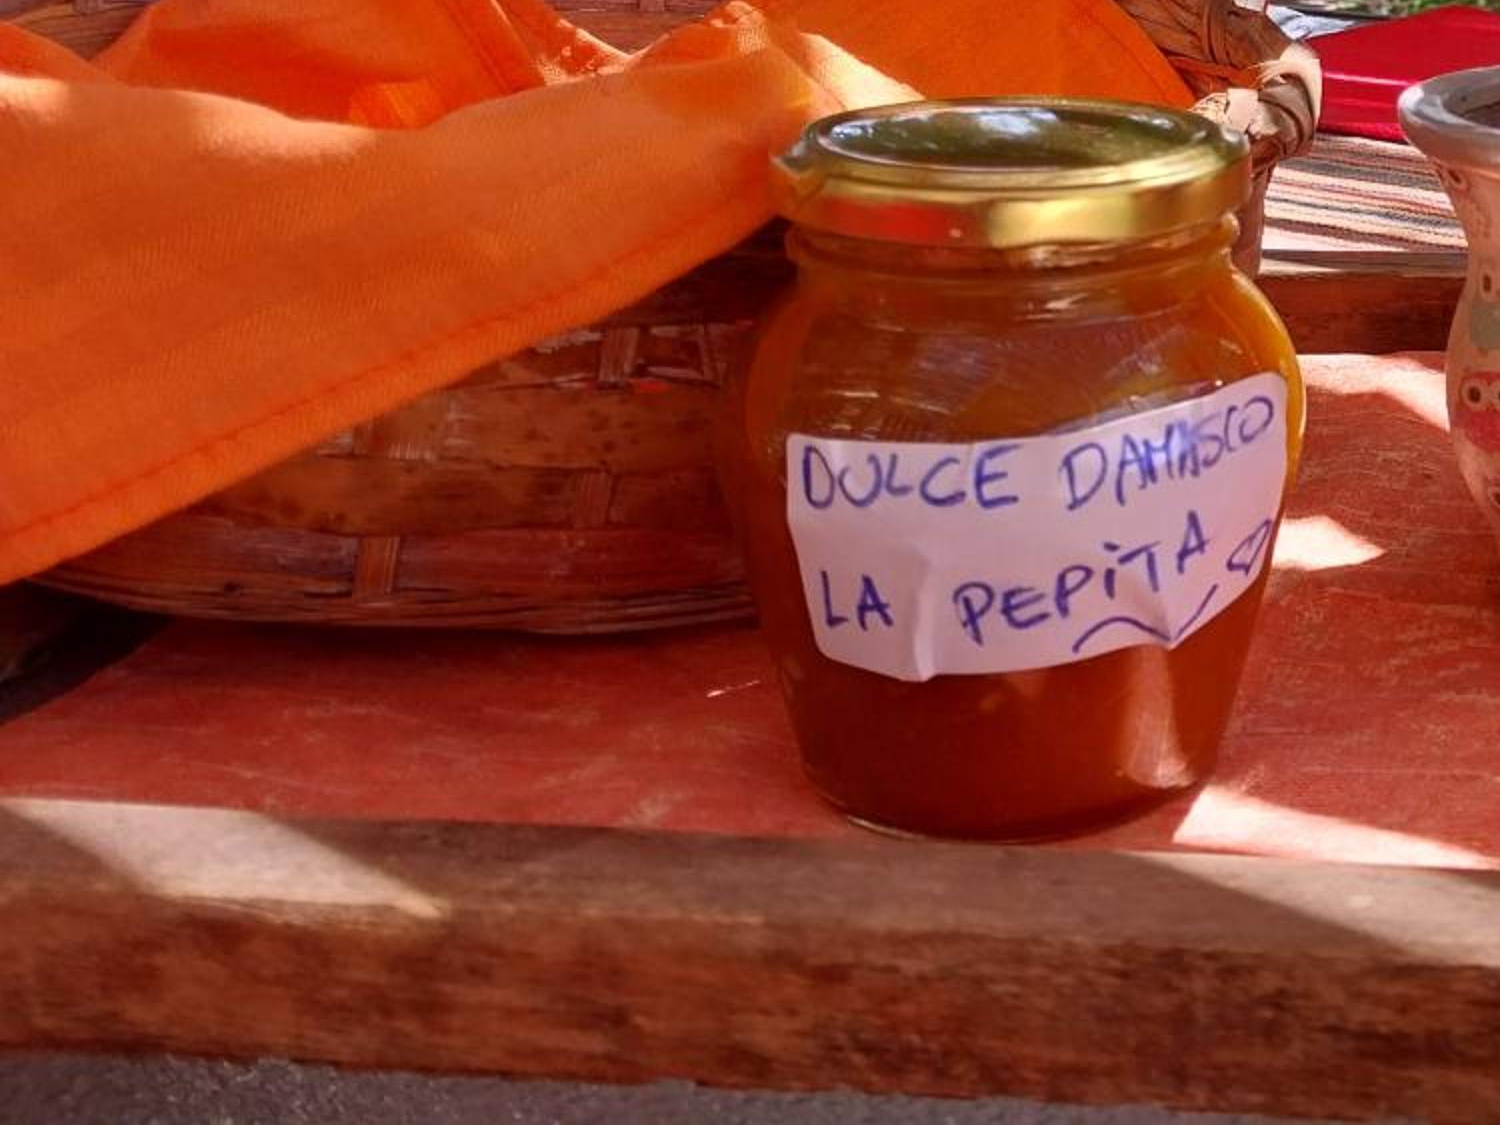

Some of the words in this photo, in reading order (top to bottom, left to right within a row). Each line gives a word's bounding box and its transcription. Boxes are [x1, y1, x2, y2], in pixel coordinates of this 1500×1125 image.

[802, 444, 1019, 509] DULCE
[1059, 396, 1274, 511] DAMASCO
[820, 570, 894, 631] LA
